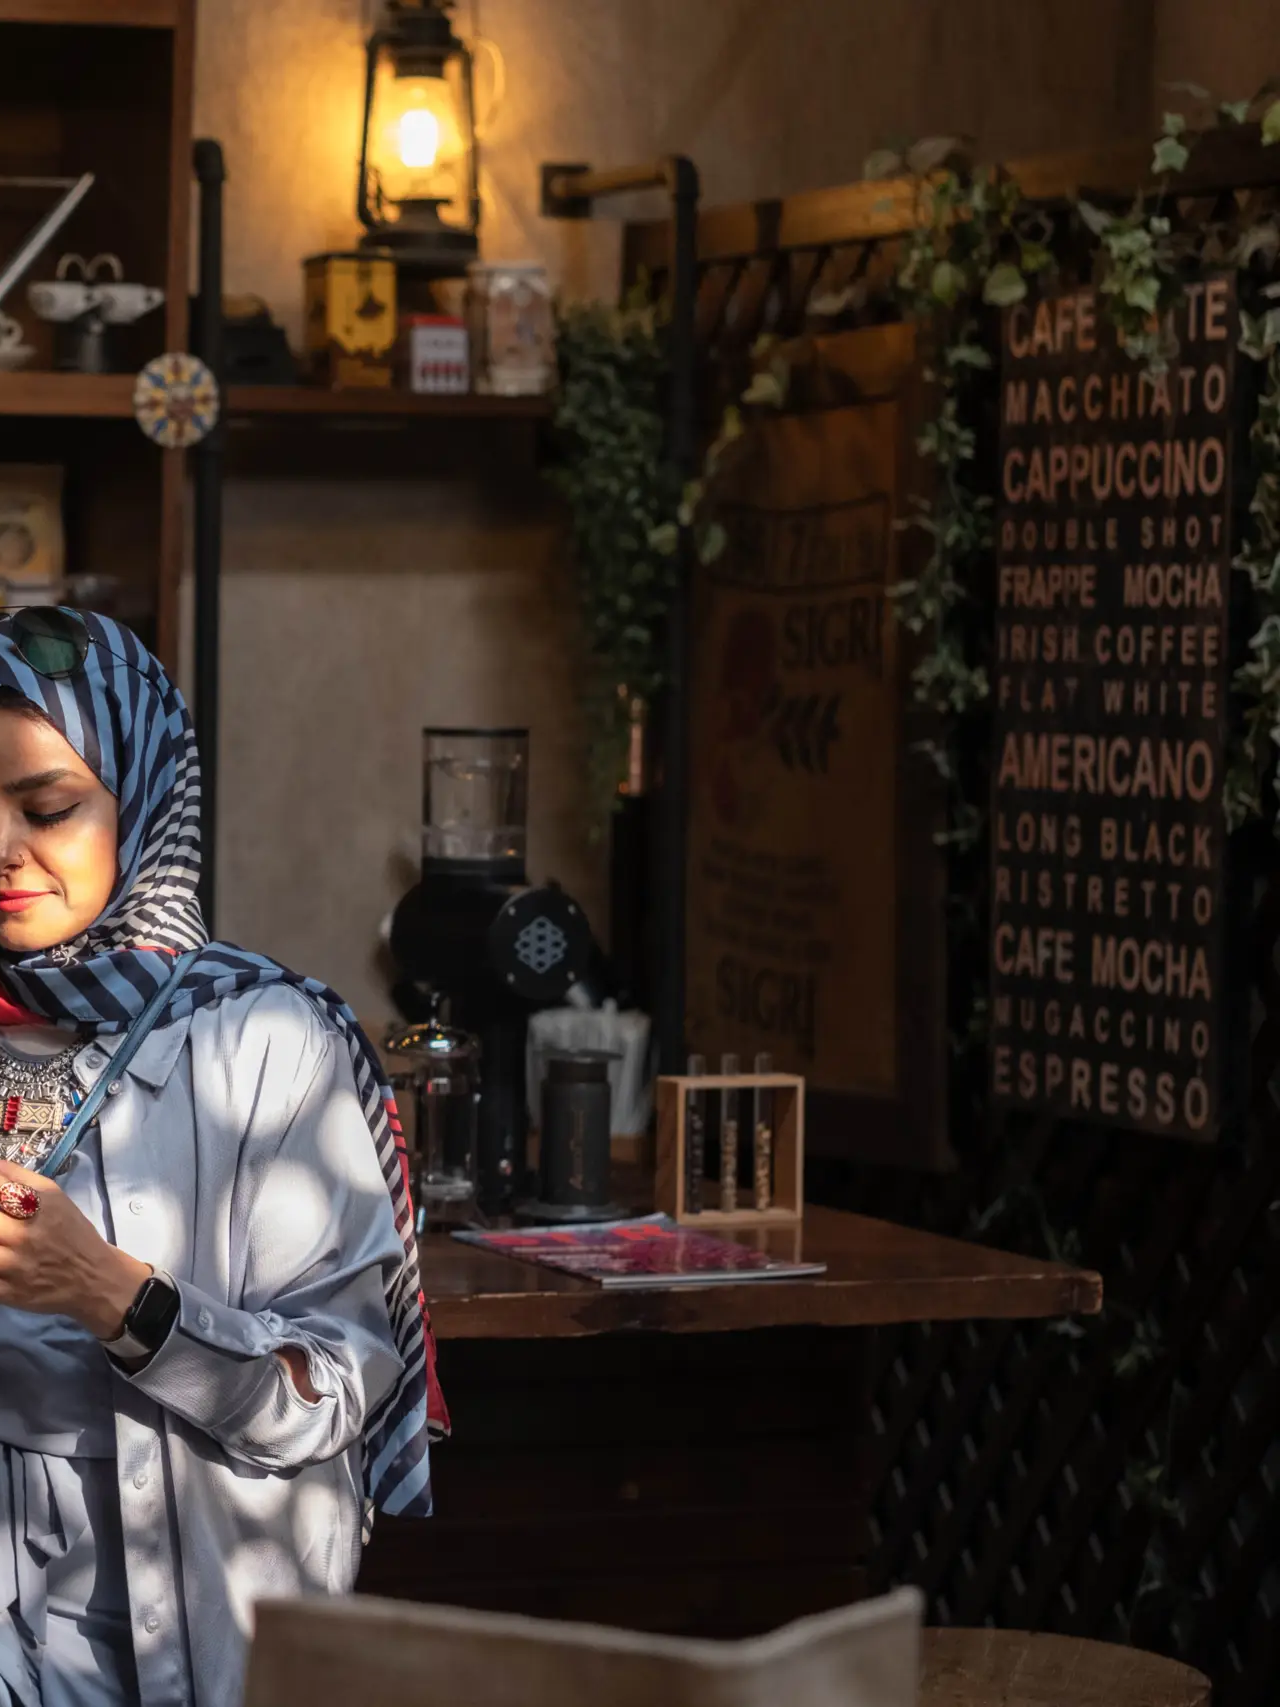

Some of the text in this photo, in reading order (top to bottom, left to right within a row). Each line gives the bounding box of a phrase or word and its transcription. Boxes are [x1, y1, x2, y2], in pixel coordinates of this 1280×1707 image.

[1009, 290, 1096, 358] CAFE
[1006, 363, 1226, 424] MACCHIATO
[1003, 436, 1225, 503] CAPPUCCINO
[1001, 514, 1222, 551] DOUBLE SHOT
[999, 562, 1222, 609] FRAPPE MOCHA
[999, 623, 1218, 667] IRISH COFFEE
[998, 674, 1217, 719] FLAT WHITE
[998, 732, 1213, 801] AMERICANO
[998, 811, 1212, 869] LONG BLACK
[995, 866, 1212, 926] RISTRETTO
[994, 921, 1211, 1000] CAFE MOCHA
[993, 1044, 1209, 1130] ESPRESSO
